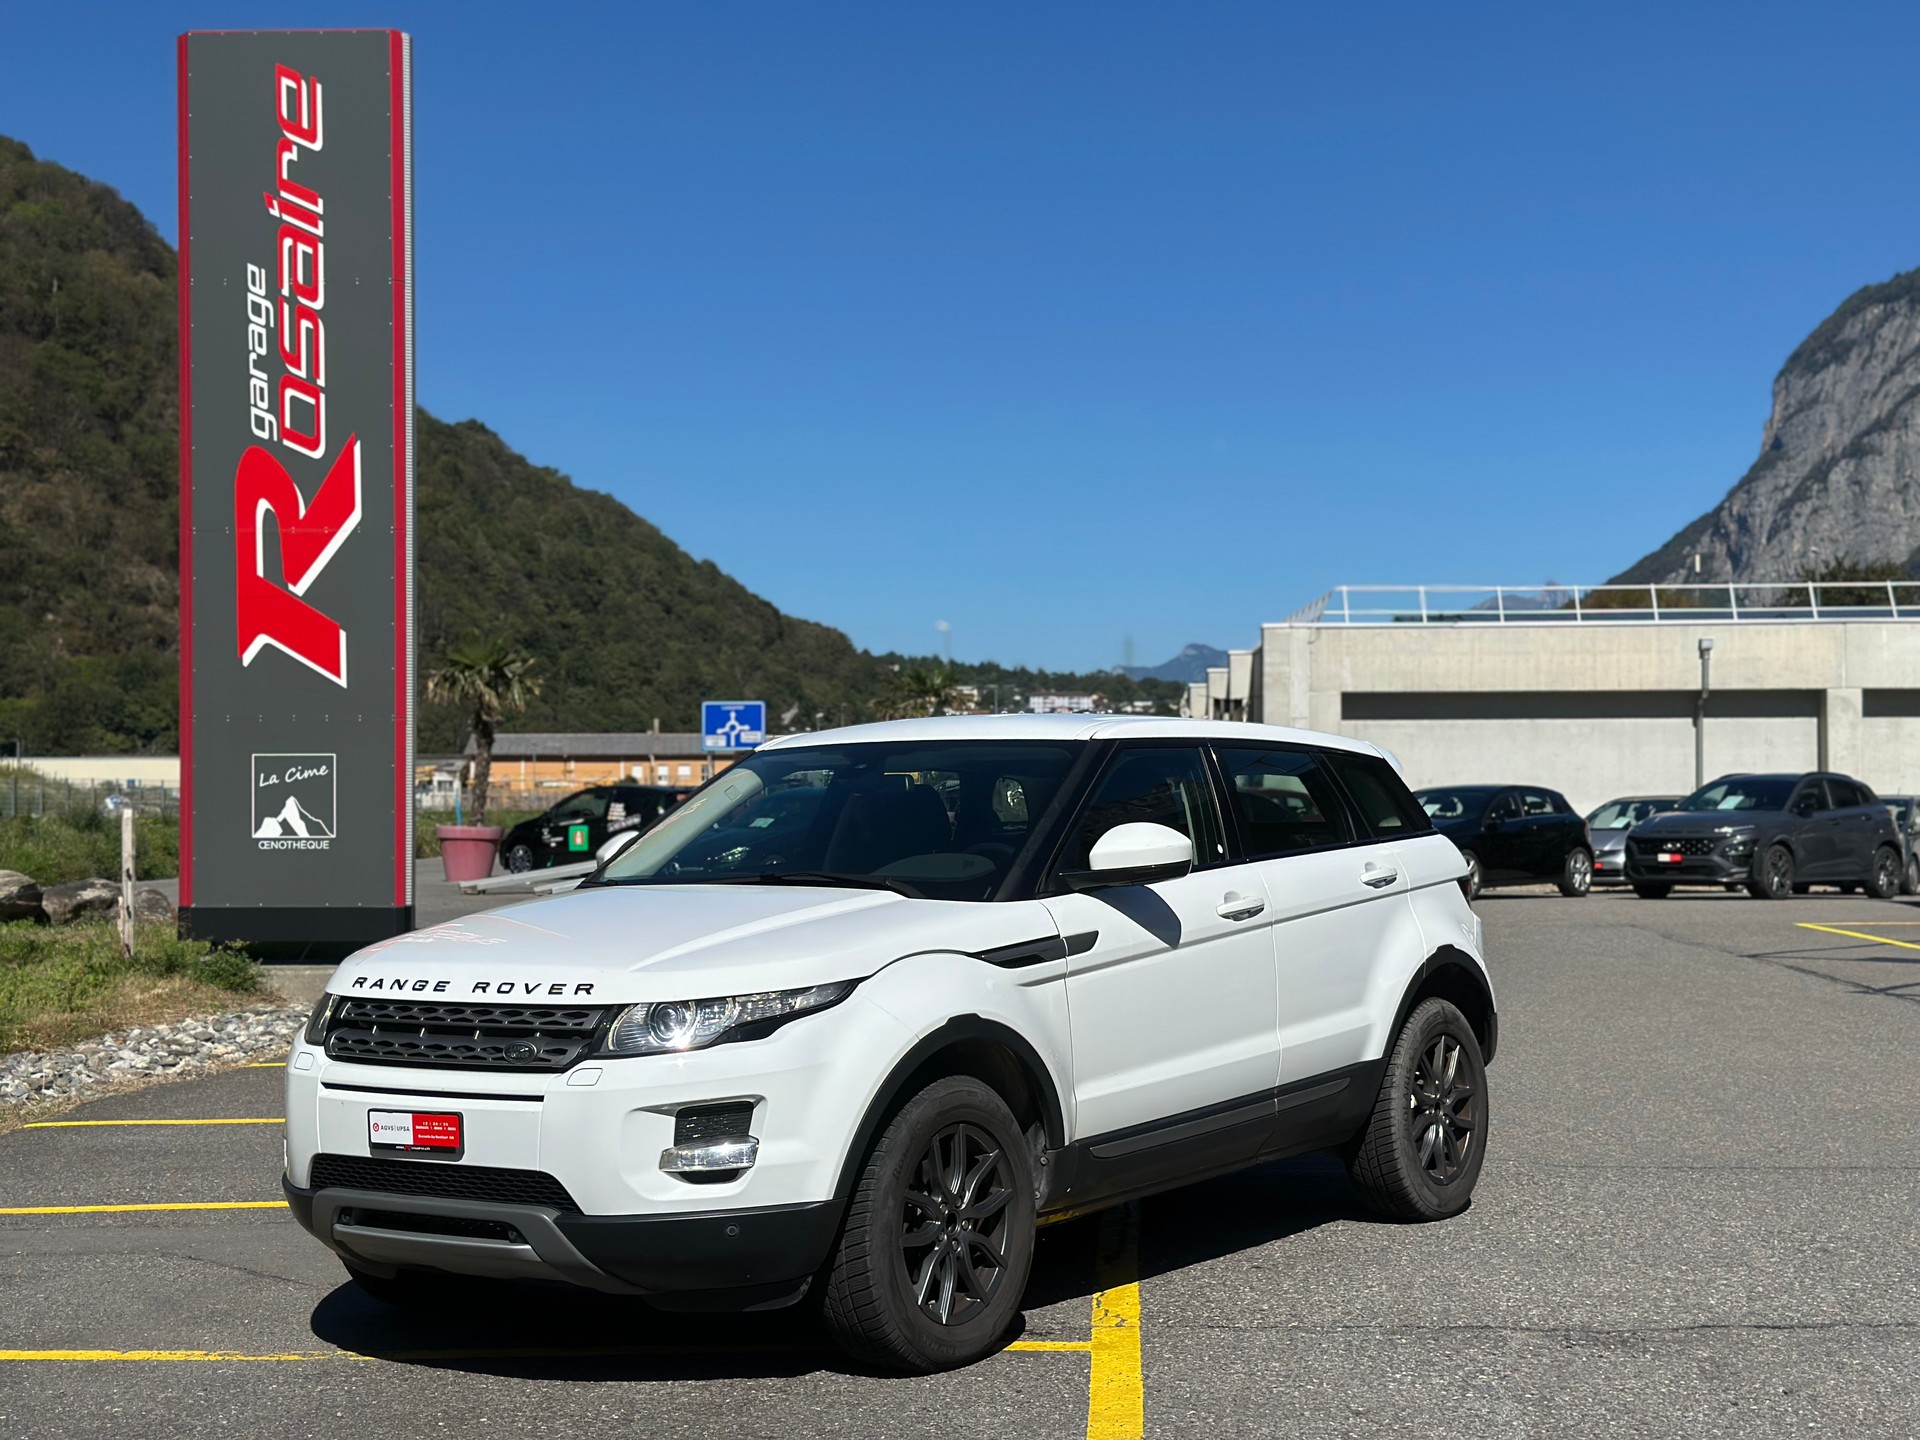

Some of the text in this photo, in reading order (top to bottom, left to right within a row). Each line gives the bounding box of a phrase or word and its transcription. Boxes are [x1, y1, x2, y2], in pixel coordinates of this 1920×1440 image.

[235, 63, 362, 688] Rosaire
[247, 263, 277, 441] garage
[259, 765, 329, 787] La Cime
[352, 977, 595, 996] RANGE ROVER
